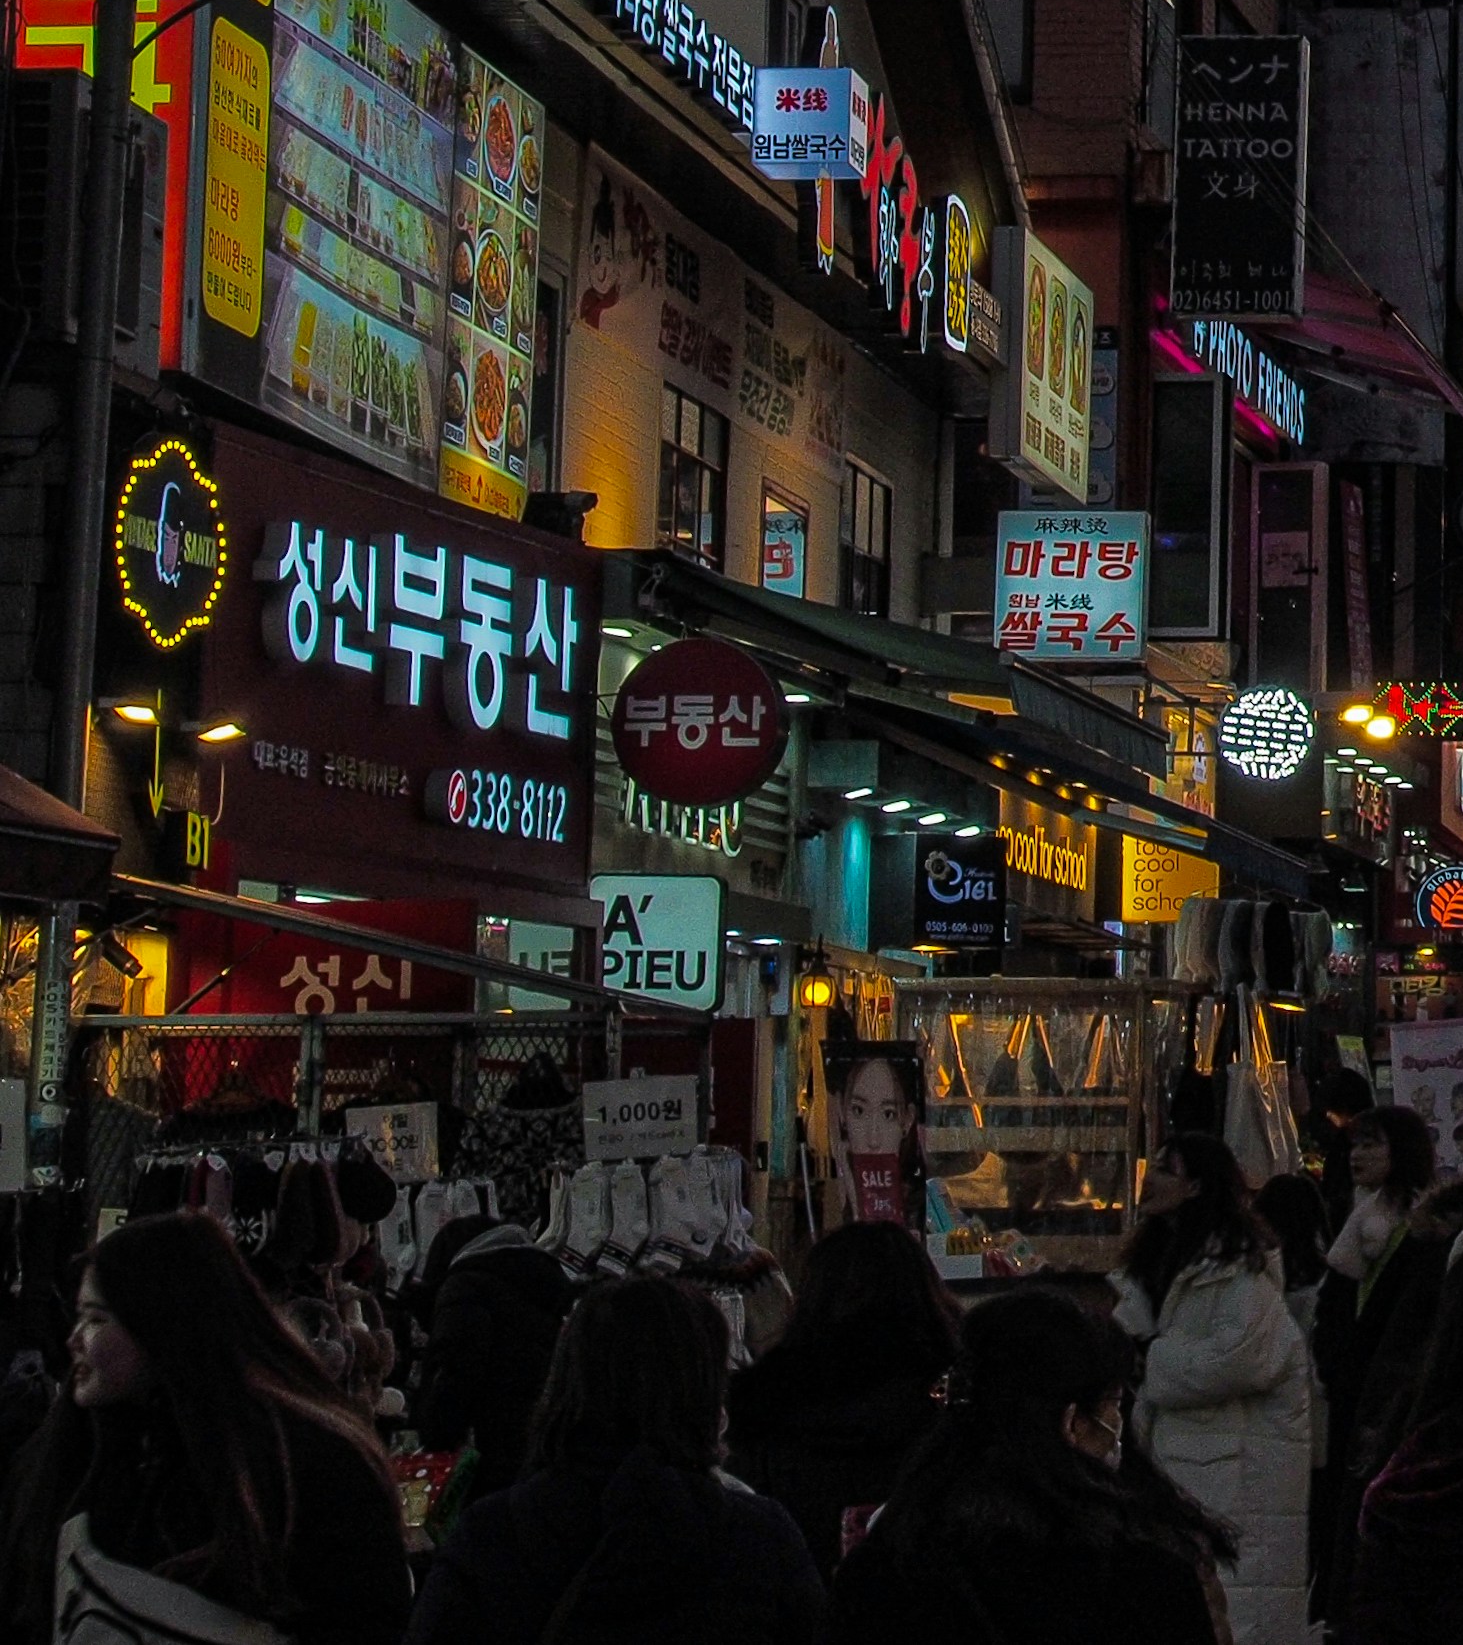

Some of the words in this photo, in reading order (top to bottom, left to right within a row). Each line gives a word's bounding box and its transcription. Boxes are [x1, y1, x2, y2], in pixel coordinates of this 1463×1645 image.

[710, 34, 756, 132] 전문점
[1191, 55, 1290, 85] ヘンナ
[775, 87, 828, 113] 米线
[1185, 101, 1289, 123] HENNA
[753, 134, 846, 160] 원남쌀국수
[1183, 138, 1294, 159] TATTOO
[210, 177, 240, 223] 마라탕
[1201, 170, 1261, 201] 文身
[1208, 320, 1253, 399] PHOTO
[1257, 352, 1305, 446] FRIENDS
[1034, 517, 1110, 535] 麻辣烫
[183, 530, 218, 569] SANTA
[1003, 539, 1140, 581] 마라탕
[1044, 592, 1095, 611] 米线
[277, 520, 580, 741] 성신부동산
[998, 611, 1137, 652] 쌀국수
[623, 694, 767, 749] 부동산
[466, 773, 569, 844] 338-8112
[185, 813, 212, 870] B1
[1053, 836, 1088, 892] school
[1133, 849, 1181, 873] cool
[1133, 874, 1162, 894] for
[1425, 870, 1463, 895] global
[1132, 892, 1183, 912] scho
[601, 949, 708, 991] PIEU
[597, 1098, 683, 1125] 1,000원
[861, 1171, 893, 1188] SALE
